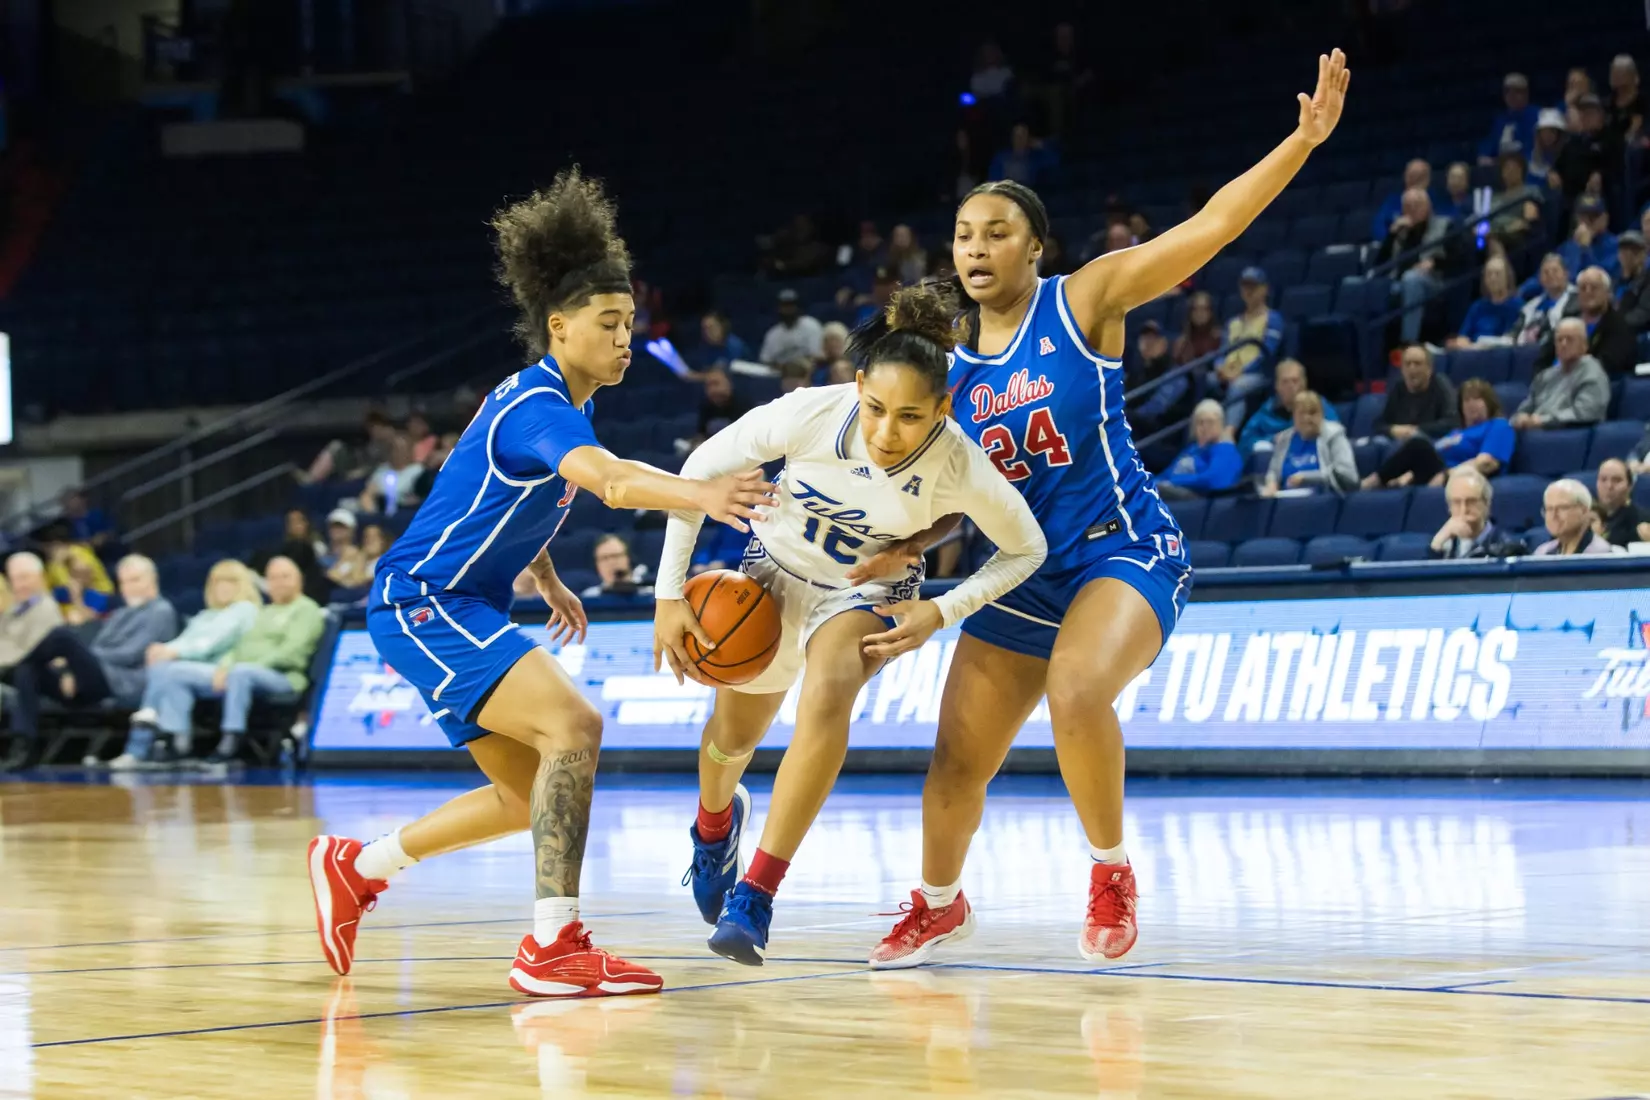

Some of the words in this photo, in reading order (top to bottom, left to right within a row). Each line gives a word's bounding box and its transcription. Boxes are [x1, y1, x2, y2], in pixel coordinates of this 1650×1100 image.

[970, 368, 1054, 423] Dallas
[981, 406, 1073, 481] 24
[791, 479, 899, 540] Tulsa
[1109, 523, 1117, 531] M
[1158, 632, 1232, 723] TU
[1223, 625, 1519, 723] ATHLETICS
